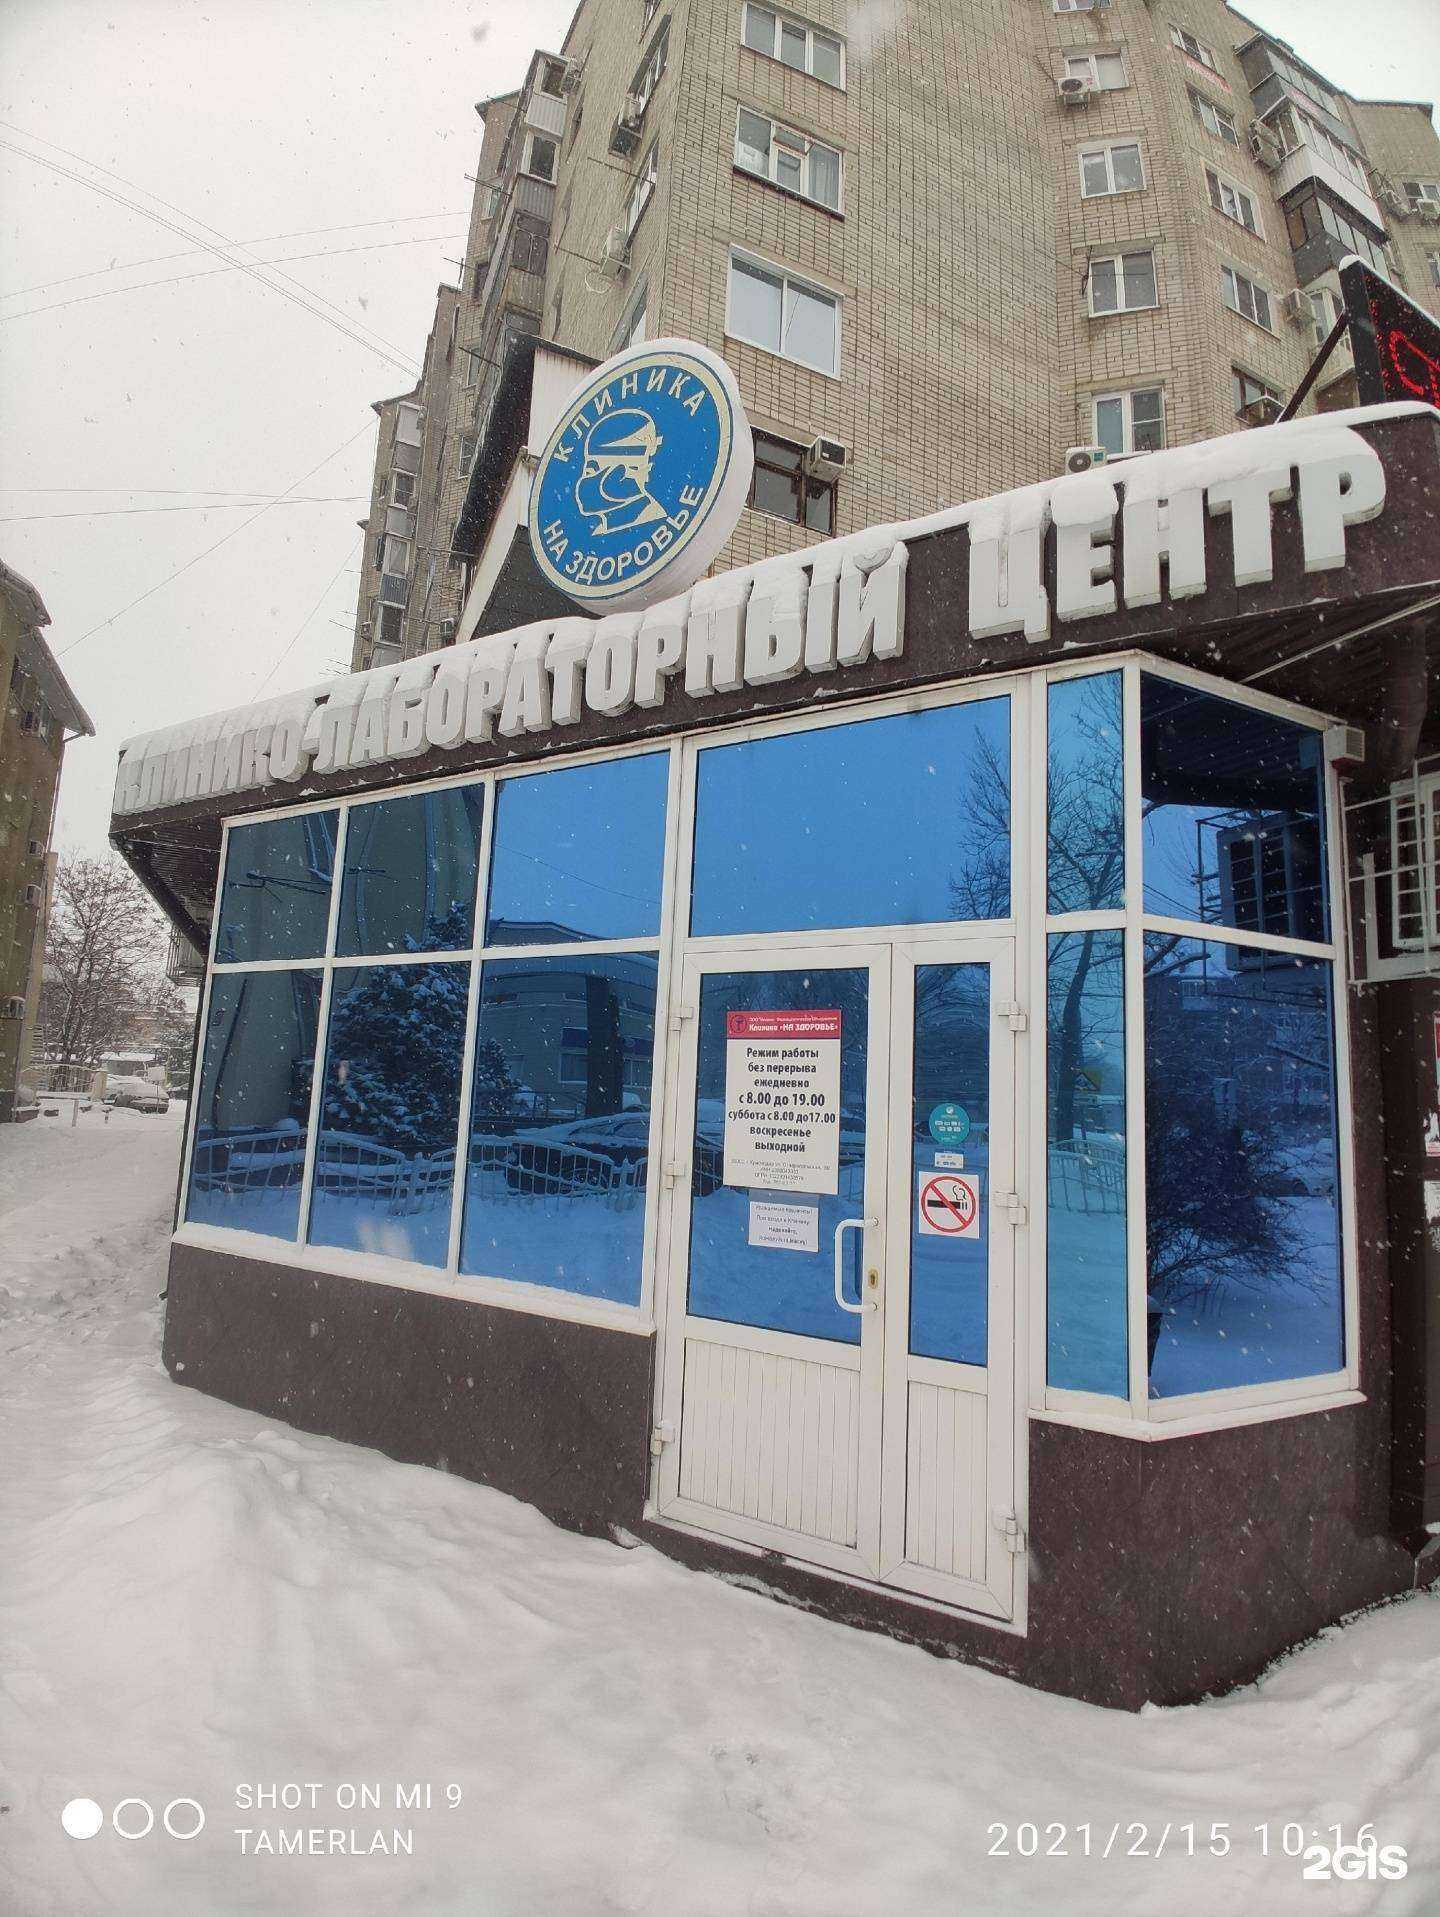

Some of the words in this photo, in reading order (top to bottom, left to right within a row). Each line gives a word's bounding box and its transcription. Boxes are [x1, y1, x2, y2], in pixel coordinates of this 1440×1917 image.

[553, 367, 707, 463] КЛИНИКА
[543, 519, 569, 562] НА
[565, 484, 703, 586] ЗДОРОВЬЕ
[967, 430, 1386, 644] ЦЕНТР
[746, 1047, 779, 1058] Режим
[781, 1047, 819, 1060] работы
[748, 1062, 765, 1072] без
[766, 1063, 817, 1075] перерыва
[754, 1078, 810, 1089] ежедневно
[739, 1094, 745, 1104] с
[746, 1092, 771, 1105] 8.00
[773, 1095, 789, 1107] до
[792, 1093, 825, 1107] 19.00
[728, 1109, 765, 1121] суббота
[773, 1111, 794, 1121] 8.00
[749, 1126, 812, 1138] воскресенье
[755, 1141, 806, 1153] выходной
